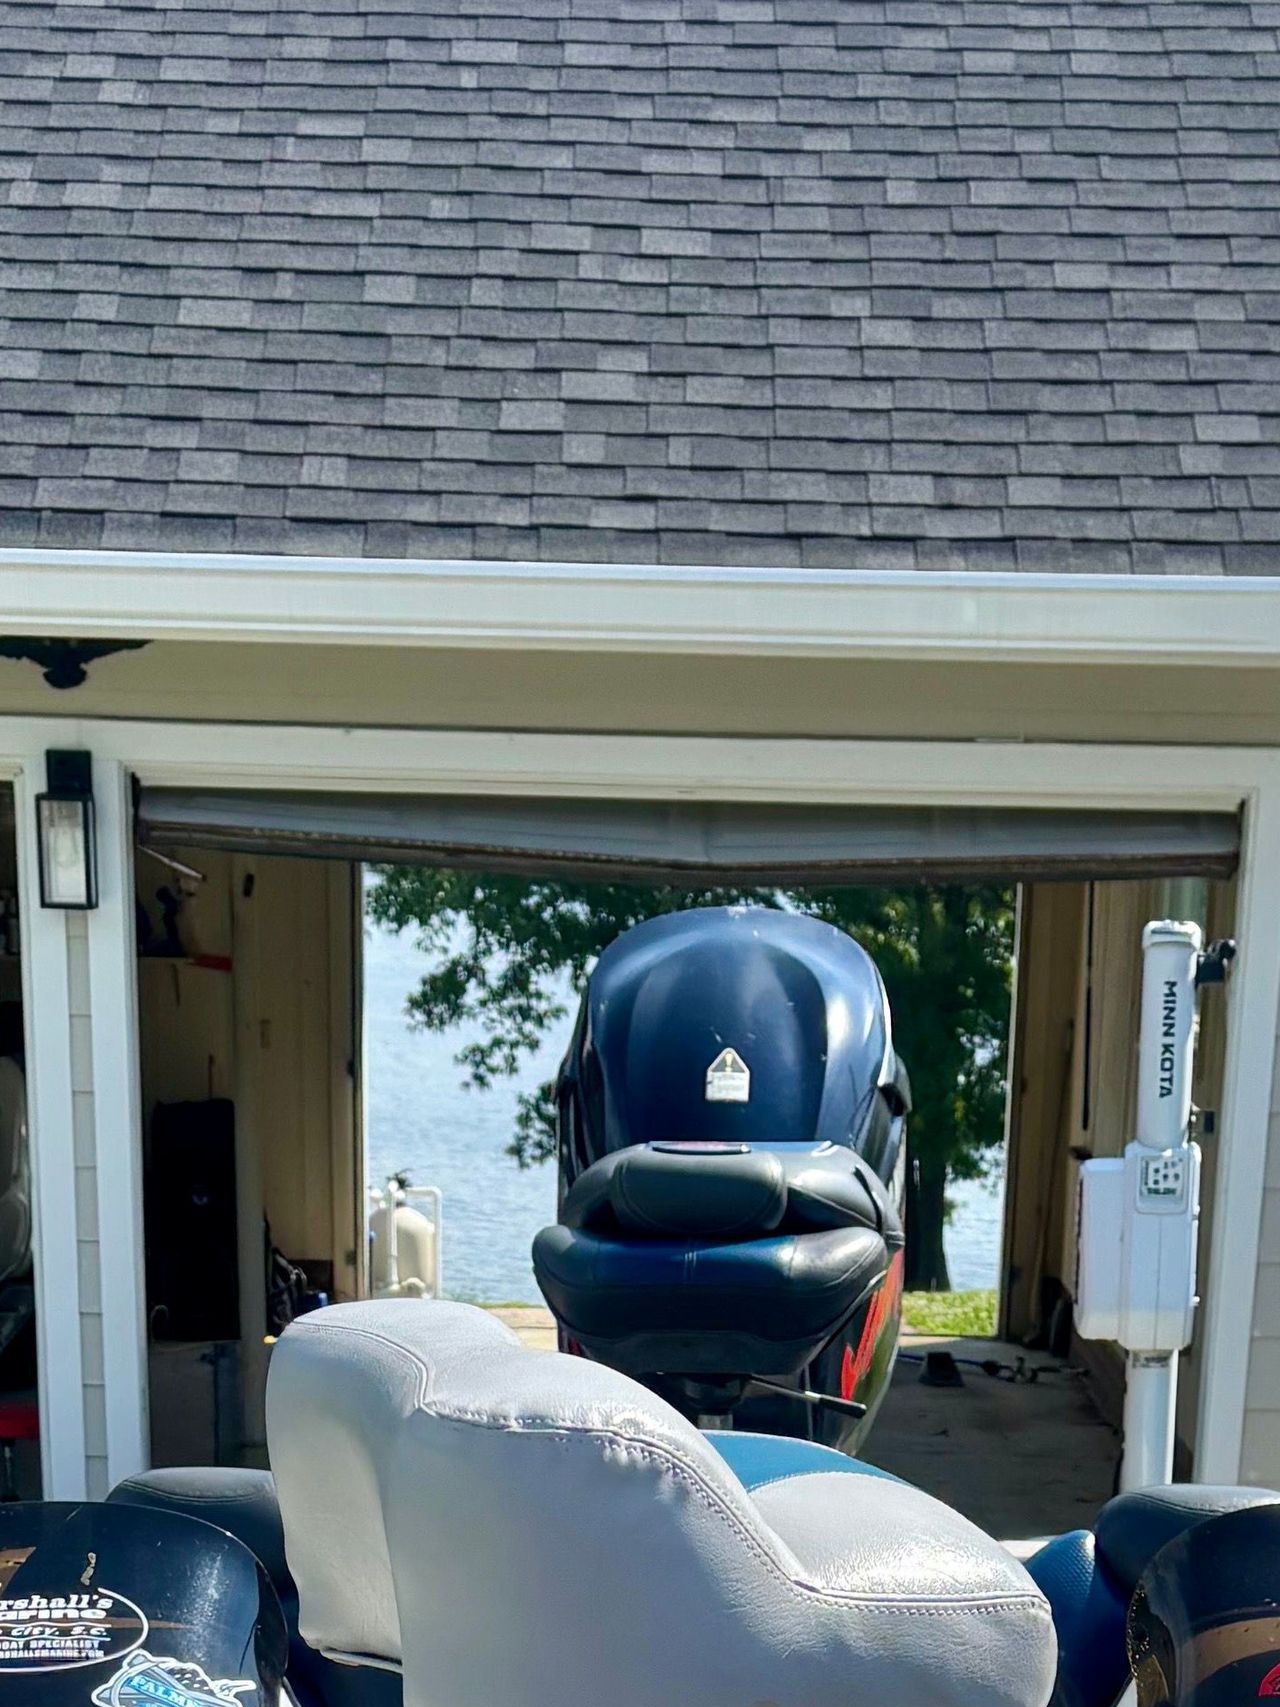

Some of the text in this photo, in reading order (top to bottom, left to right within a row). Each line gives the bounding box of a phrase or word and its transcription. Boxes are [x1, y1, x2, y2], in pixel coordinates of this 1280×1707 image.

[1159, 981, 1177, 1098] MINN KOTA
[30, 1640, 99, 1649] SPECIALIST
